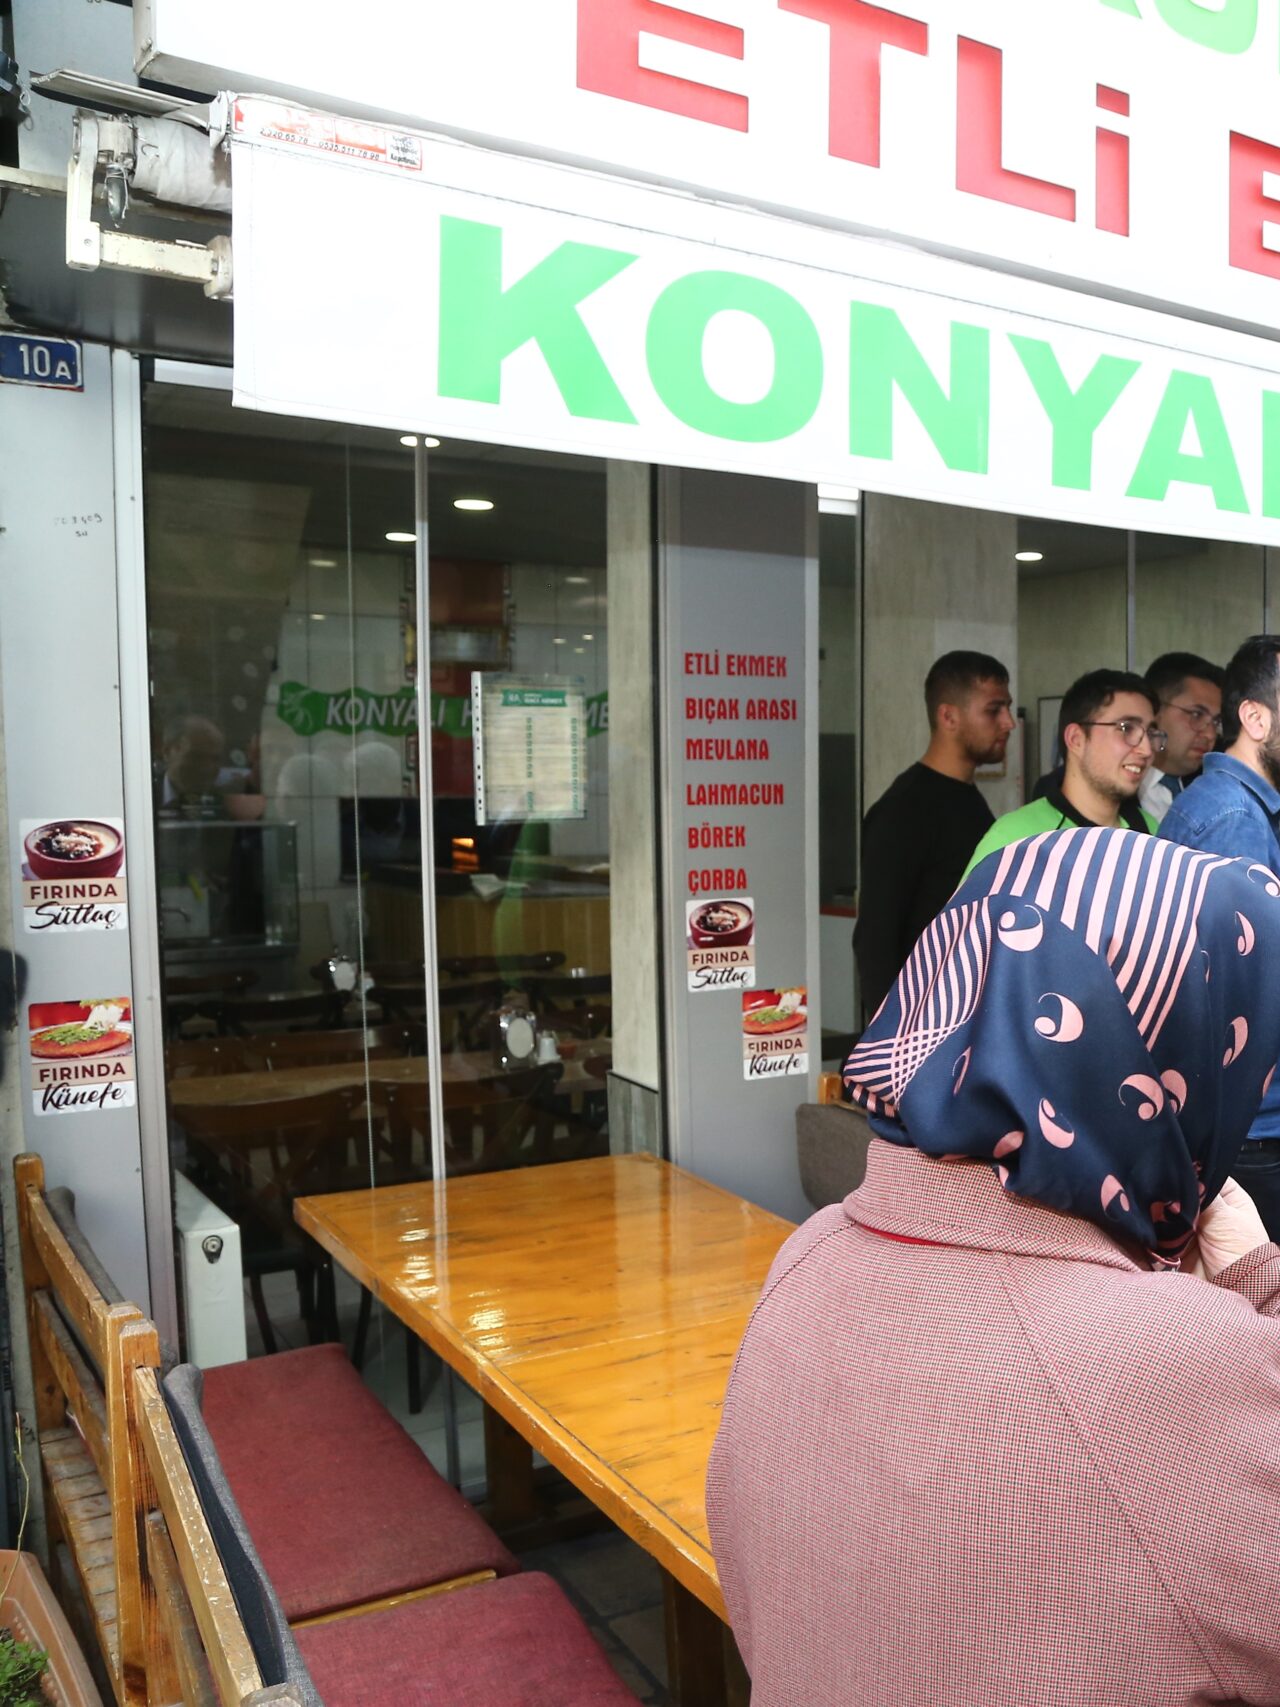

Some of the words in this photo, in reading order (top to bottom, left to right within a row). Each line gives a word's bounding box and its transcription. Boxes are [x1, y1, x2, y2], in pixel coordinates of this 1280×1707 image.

[684, 649, 719, 676] ETLİ
[726, 654, 788, 678] EKMEK
[685, 697, 740, 724] BIÇAK
[745, 698, 797, 721] ARASI
[686, 783, 784, 806] LAHMACUN
[688, 822, 746, 849] BÖREK
[30, 883, 118, 900] FIRINDA
[688, 869, 748, 896] ÇORBA
[29, 901, 121, 930] Sütlaç
[692, 950, 750, 966] FIRINDA
[691, 965, 750, 989] Sütlaç
[39, 1061, 127, 1083] FIRINDA
[749, 1053, 803, 1076] Künefe
[42, 1081, 127, 1112] Künefe
